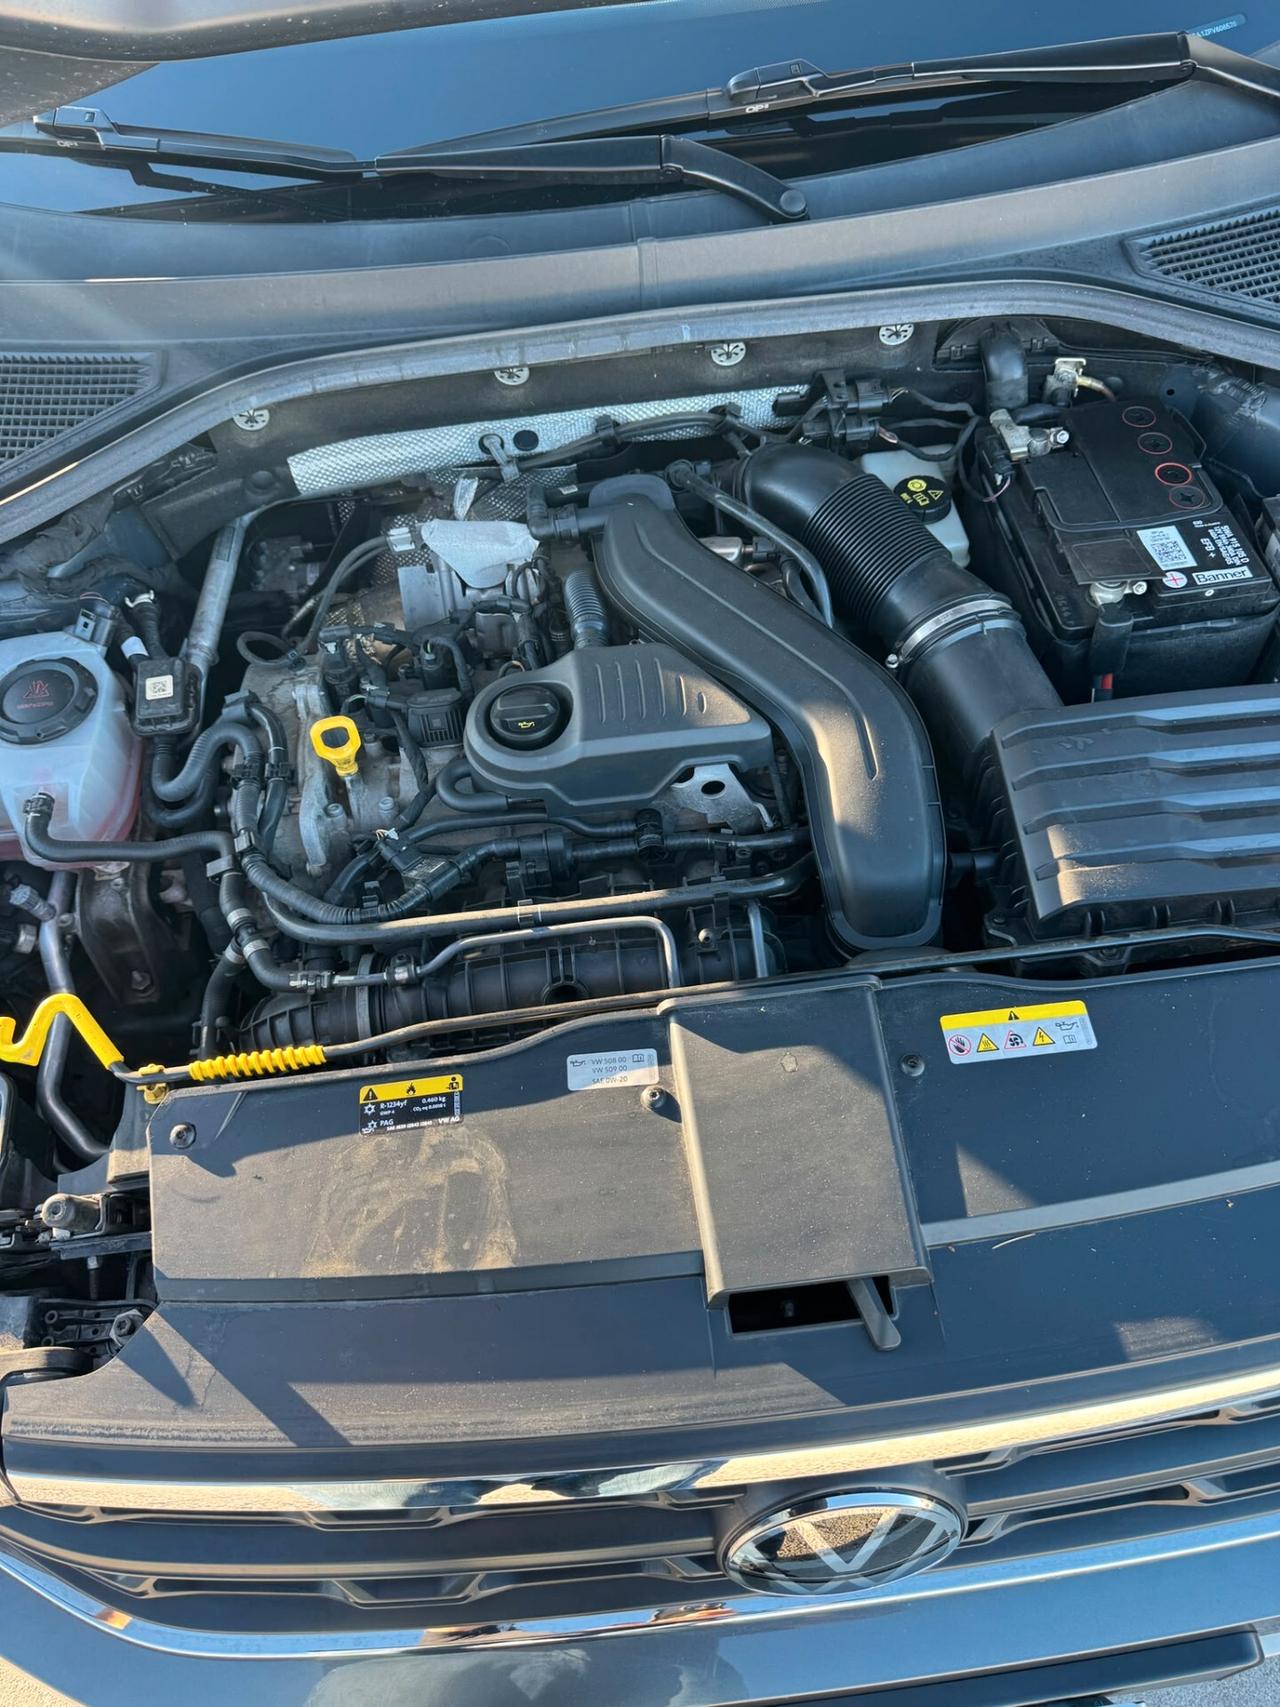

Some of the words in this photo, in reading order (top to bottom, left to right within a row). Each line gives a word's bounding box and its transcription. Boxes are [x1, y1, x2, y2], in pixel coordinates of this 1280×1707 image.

[1200, 538, 1215, 551] EFB
[1195, 570, 1247, 583] Banner
[380, 1100, 407, 1109] R-1234yf
[439, 1095, 446, 1103] kg
